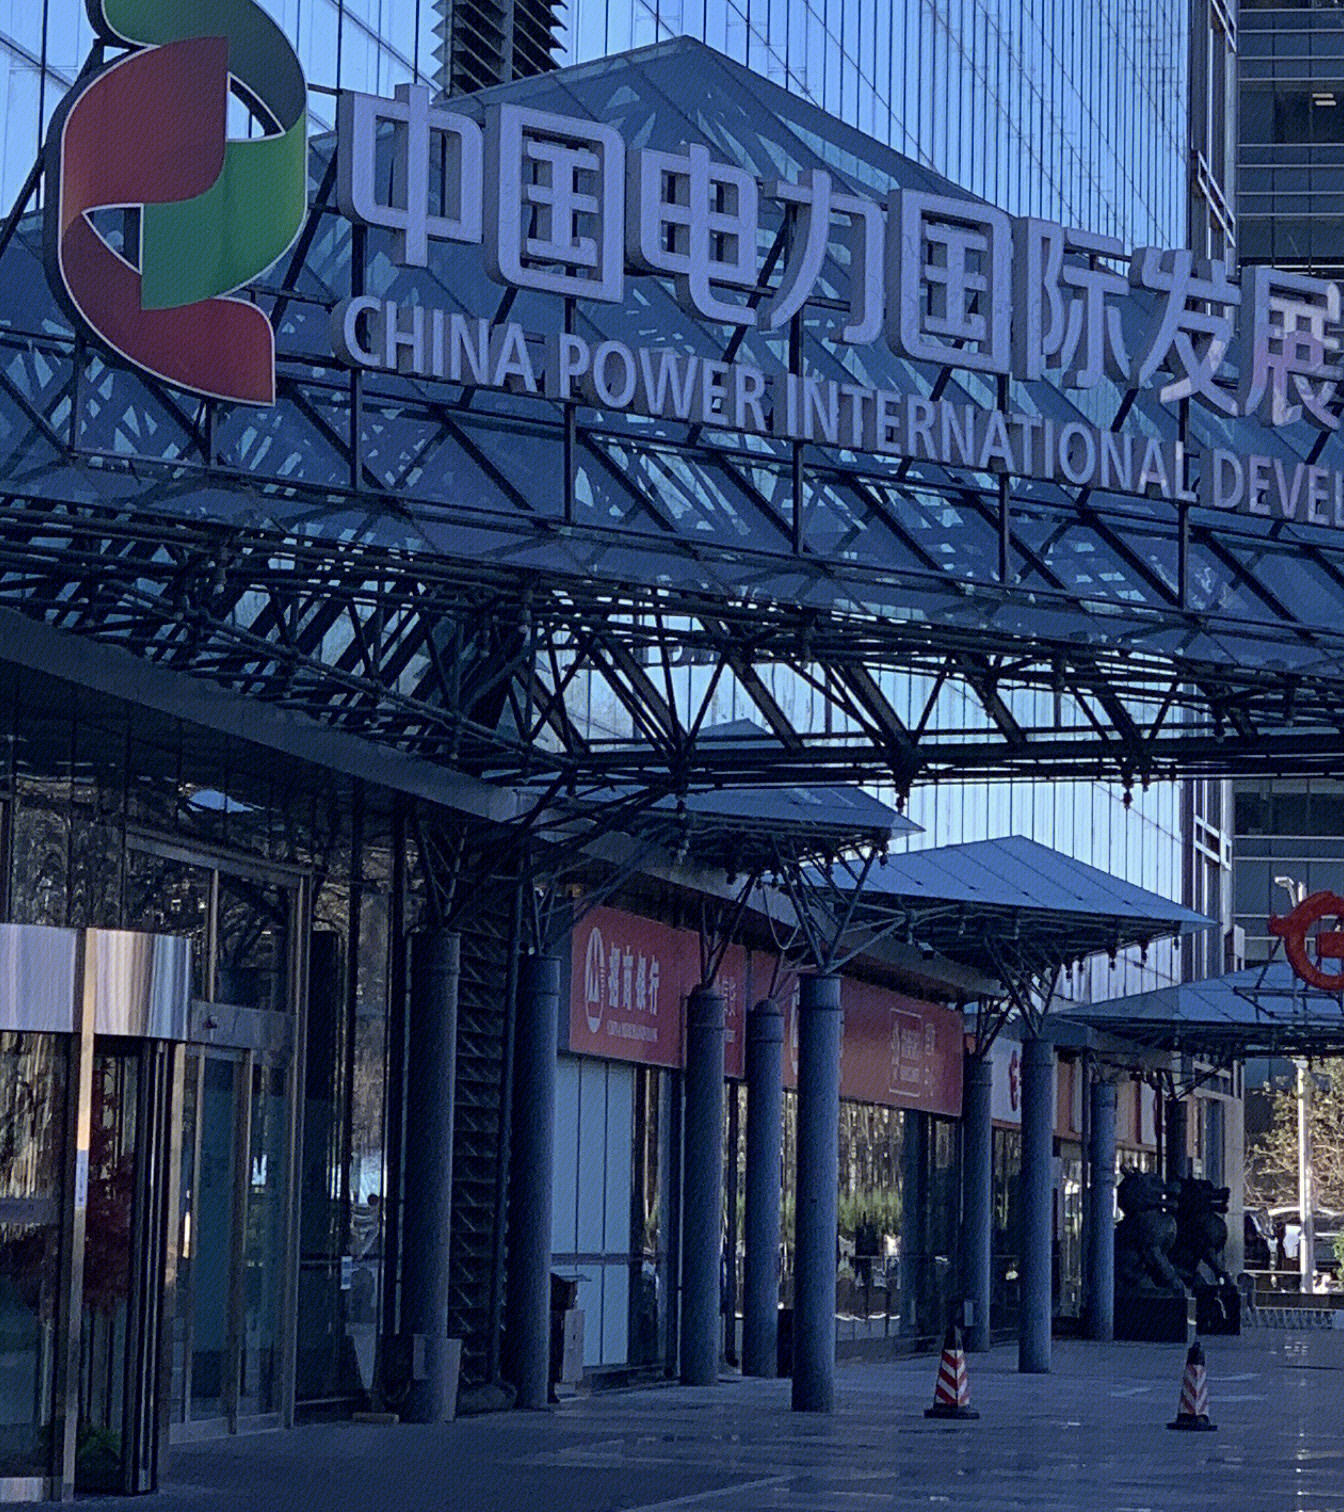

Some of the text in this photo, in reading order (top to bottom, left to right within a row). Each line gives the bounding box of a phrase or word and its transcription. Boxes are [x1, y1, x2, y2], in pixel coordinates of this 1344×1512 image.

[336, 295, 537, 393] CHINA
[556, 333, 768, 431] POWER
[778, 372, 1197, 503] INTERNATIONAL
